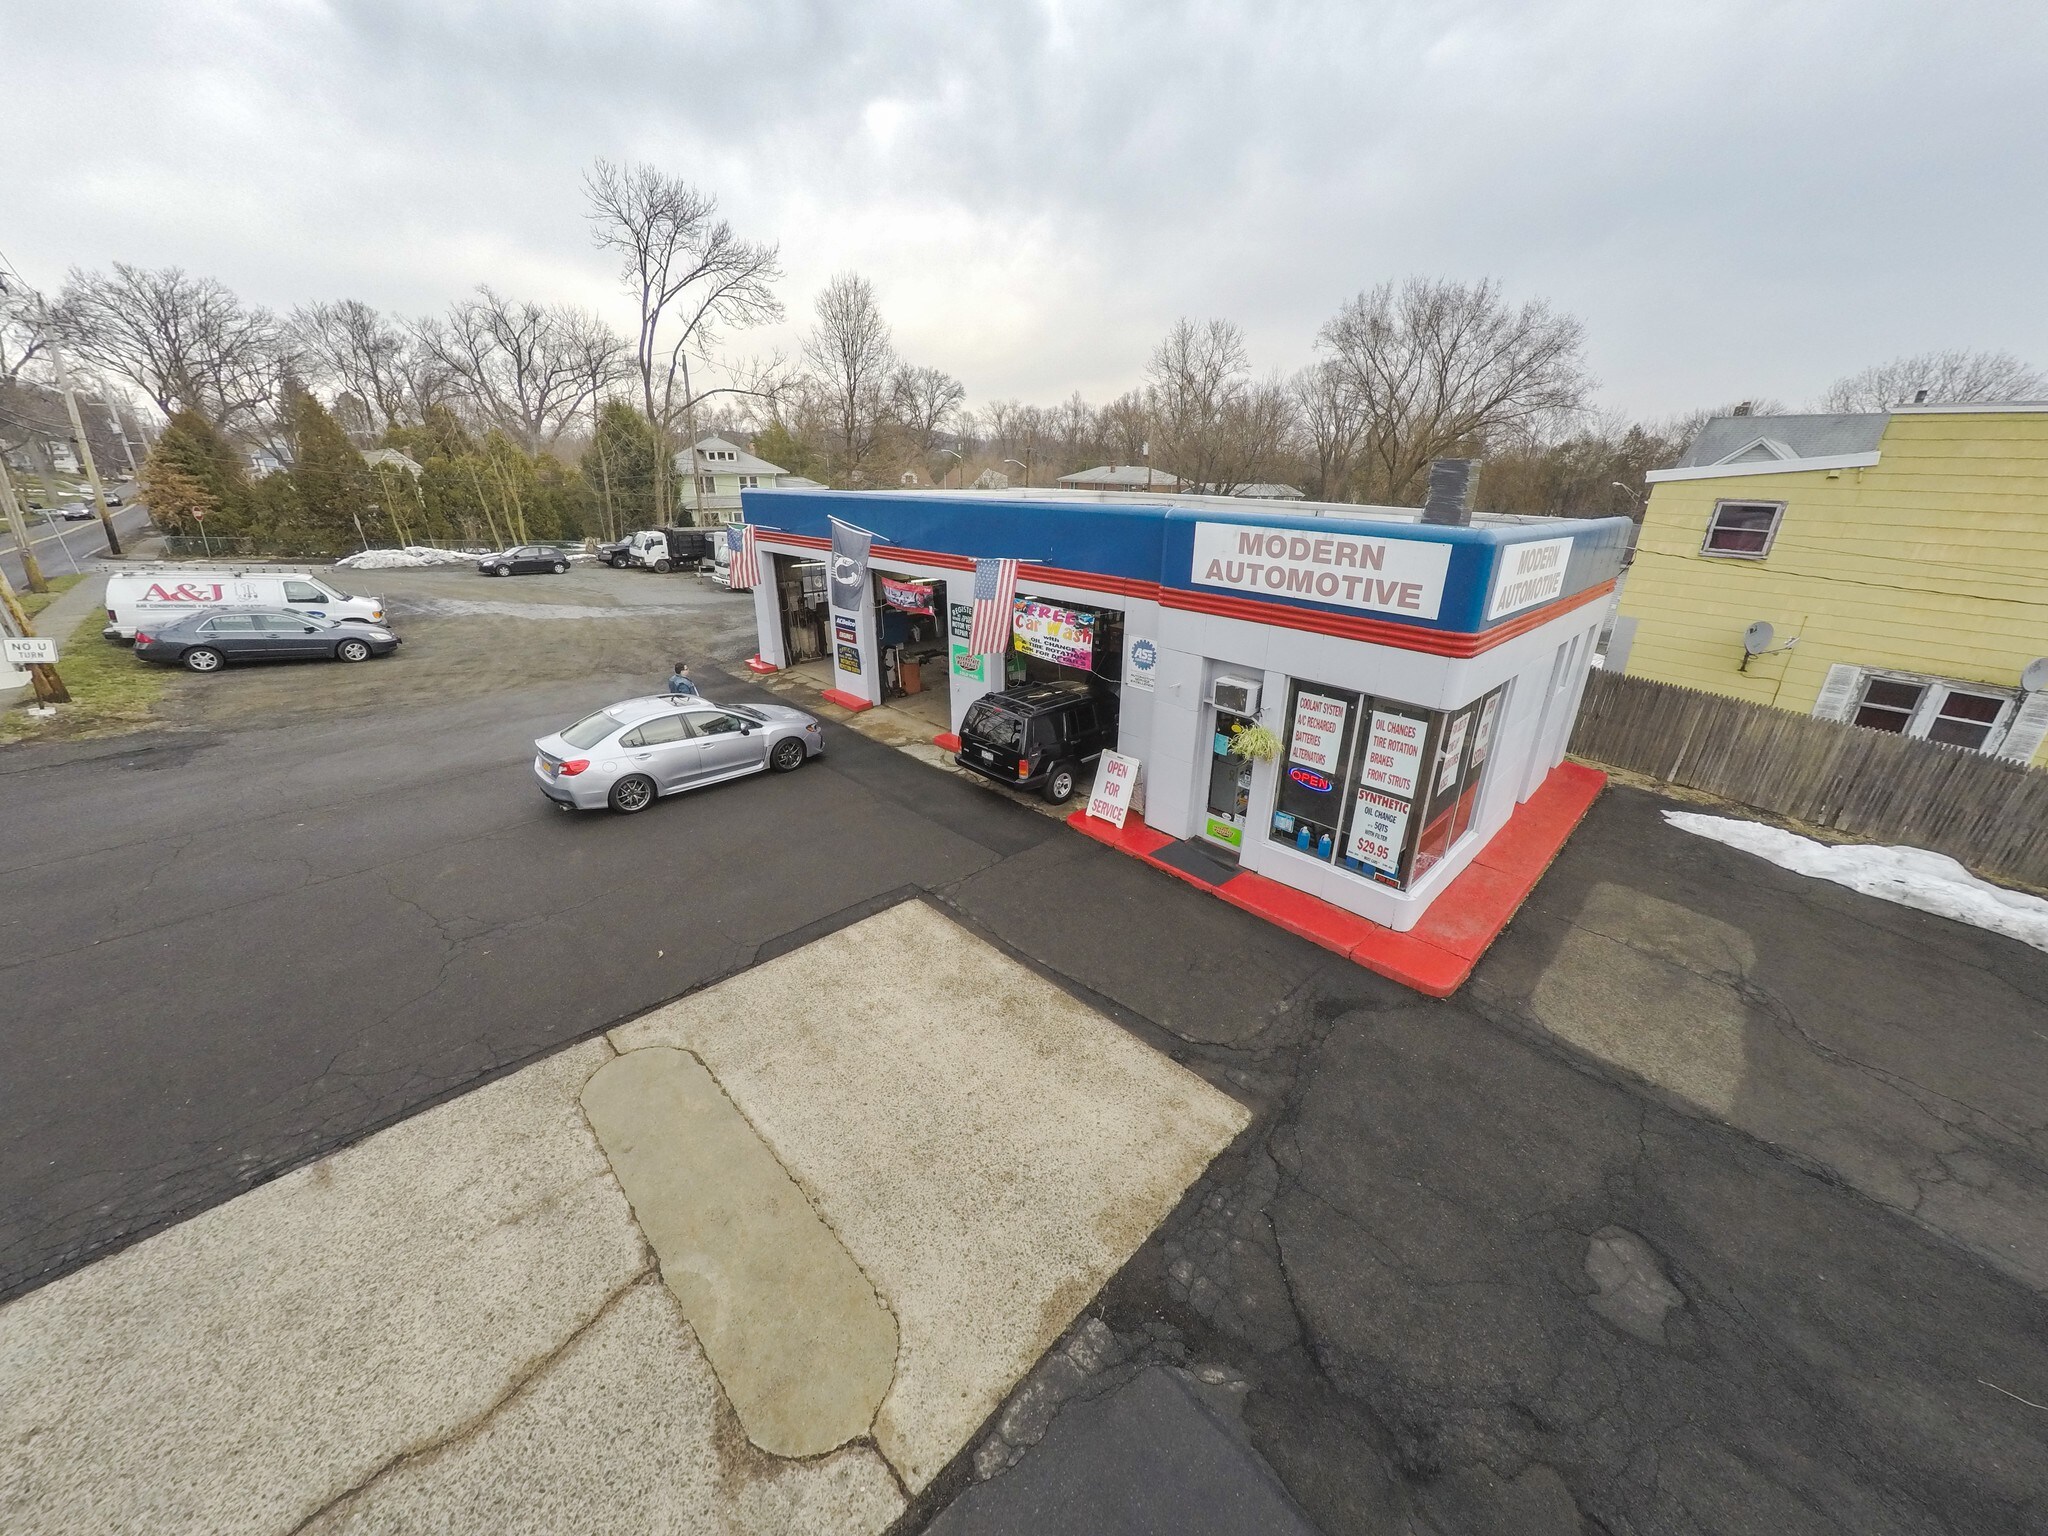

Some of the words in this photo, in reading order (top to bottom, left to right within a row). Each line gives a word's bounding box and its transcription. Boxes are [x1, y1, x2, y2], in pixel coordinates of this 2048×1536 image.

[1238, 532, 1386, 571] MODERN
[1516, 545, 1561, 575] MODERN
[136, 583, 225, 602] A&J
[1205, 558, 1423, 610] AUTOMOTIVE
[1496, 571, 1561, 612] AUTOMOTIVE
[952, 606, 972, 616] REGISTE
[1027, 604, 1076, 625] FREE
[836, 617, 855, 627] ACDelco
[1015, 614, 1041, 632] Car
[1047, 621, 1092, 644] Wash
[1030, 636, 1042, 644] OIL
[1043, 635, 1060, 643] with
[1029, 642, 1044, 650] TIRE
[1045, 646, 1086, 660] ROTATION
[1036, 649, 1050, 657] FOR
[1051, 653, 1086, 666] DETAILS
[1134, 647, 1153, 661] ASE
[1300, 697, 1322, 713] COOLANT
[1322, 703, 1344, 718] SYSTEM
[1297, 714, 1306, 726] A/C
[1307, 716, 1337, 733] RECHARGED
[1375, 719, 1385, 731] OIL
[1387, 722, 1416, 739] CHANGES
[1295, 731, 1321, 747] BATTERIES
[1373, 735, 1387, 748] TIRE
[1387, 739, 1418, 757] ROTATION
[1292, 747, 1326, 765] ALTERNATORS
[1369, 752, 1394, 768] BRAKES
[1107, 760, 1128, 778] OPEN
[1291, 770, 1328, 789] OPEN
[1367, 768, 1387, 783] FRONT
[1387, 774, 1411, 790] STRUTS
[1104, 781, 1120, 798] FOR
[1092, 799, 1123, 821] SERVICE
[1358, 790, 1409, 815] SYNTHETIC
[1364, 806, 1373, 816] OIL
[1374, 810, 1397, 824] CHANGE
[1364, 829, 1374, 837] WITH
[1374, 832, 1388, 842] FILTER
[1357, 837, 1389, 860] $29.95
